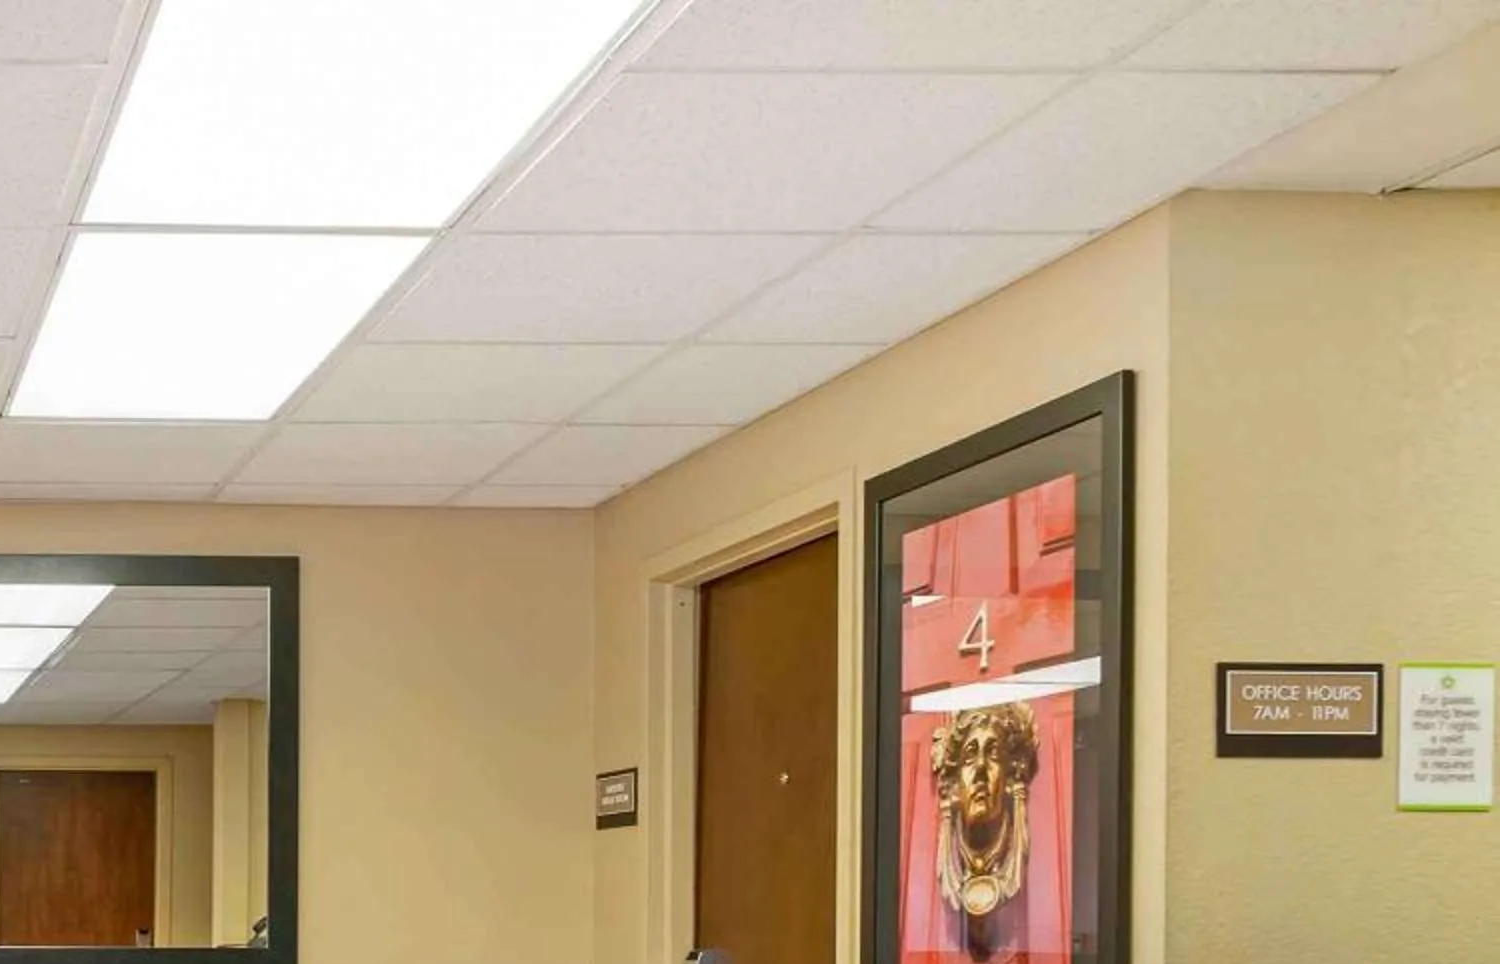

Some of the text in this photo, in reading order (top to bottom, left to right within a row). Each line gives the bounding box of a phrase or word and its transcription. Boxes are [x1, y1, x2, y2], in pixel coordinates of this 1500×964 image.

[958, 600, 995, 668] 4
[1242, 685, 1363, 701] OFFICE HOURS
[1252, 705, 1290, 721] 7AM
[1312, 705, 1350, 721] 11PM
